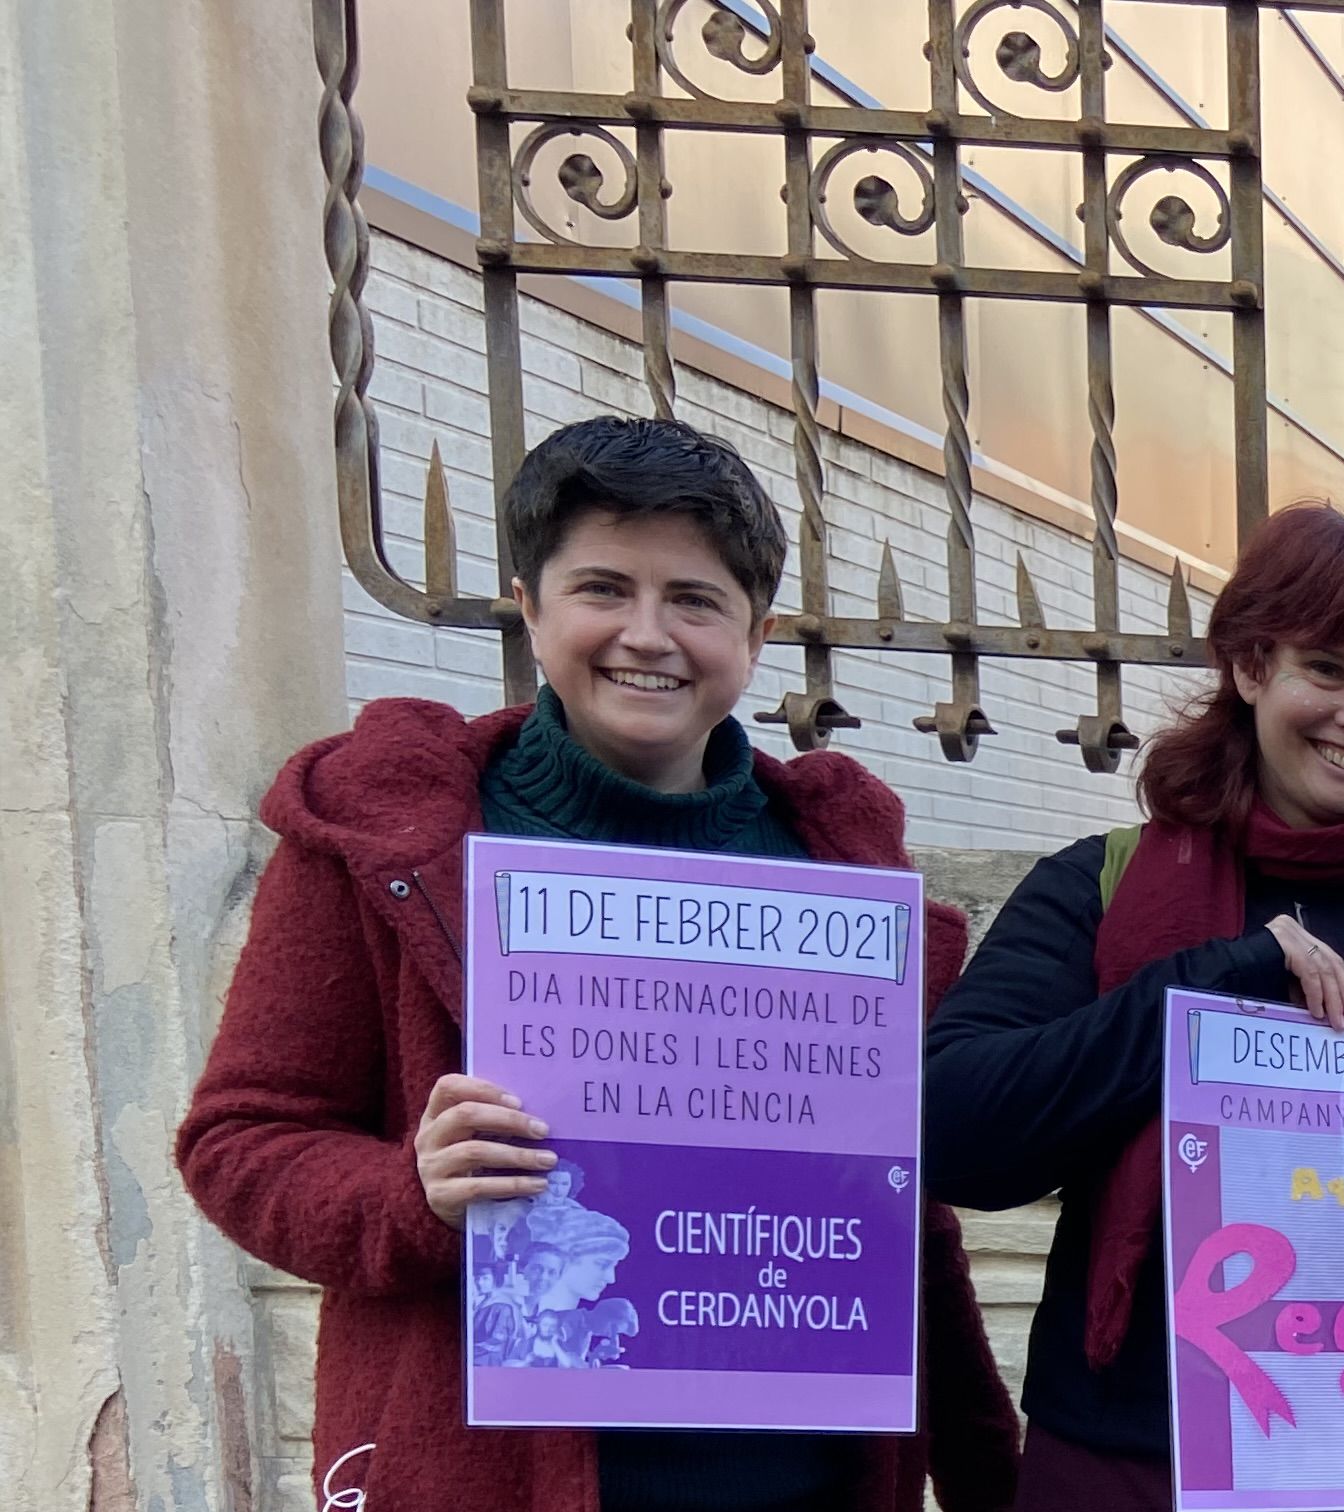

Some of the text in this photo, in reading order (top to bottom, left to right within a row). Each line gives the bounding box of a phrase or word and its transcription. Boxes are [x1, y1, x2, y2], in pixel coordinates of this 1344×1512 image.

[519, 886, 891, 961] 11 DE FEBRER 2021
[508, 970, 887, 1027] DIA INTERNACIONAL DE
[503, 1024, 555, 1058] LES
[572, 1028, 678, 1066] DONES
[718, 1037, 768, 1071] LES
[784, 1042, 882, 1078] NENES
[583, 1081, 816, 1125] EN LA CIÈNCIA
[655, 1206, 862, 1263] CIENTÍFIQUES
[758, 1261, 787, 1289] de
[658, 1290, 868, 1331] CERDANYOLA
